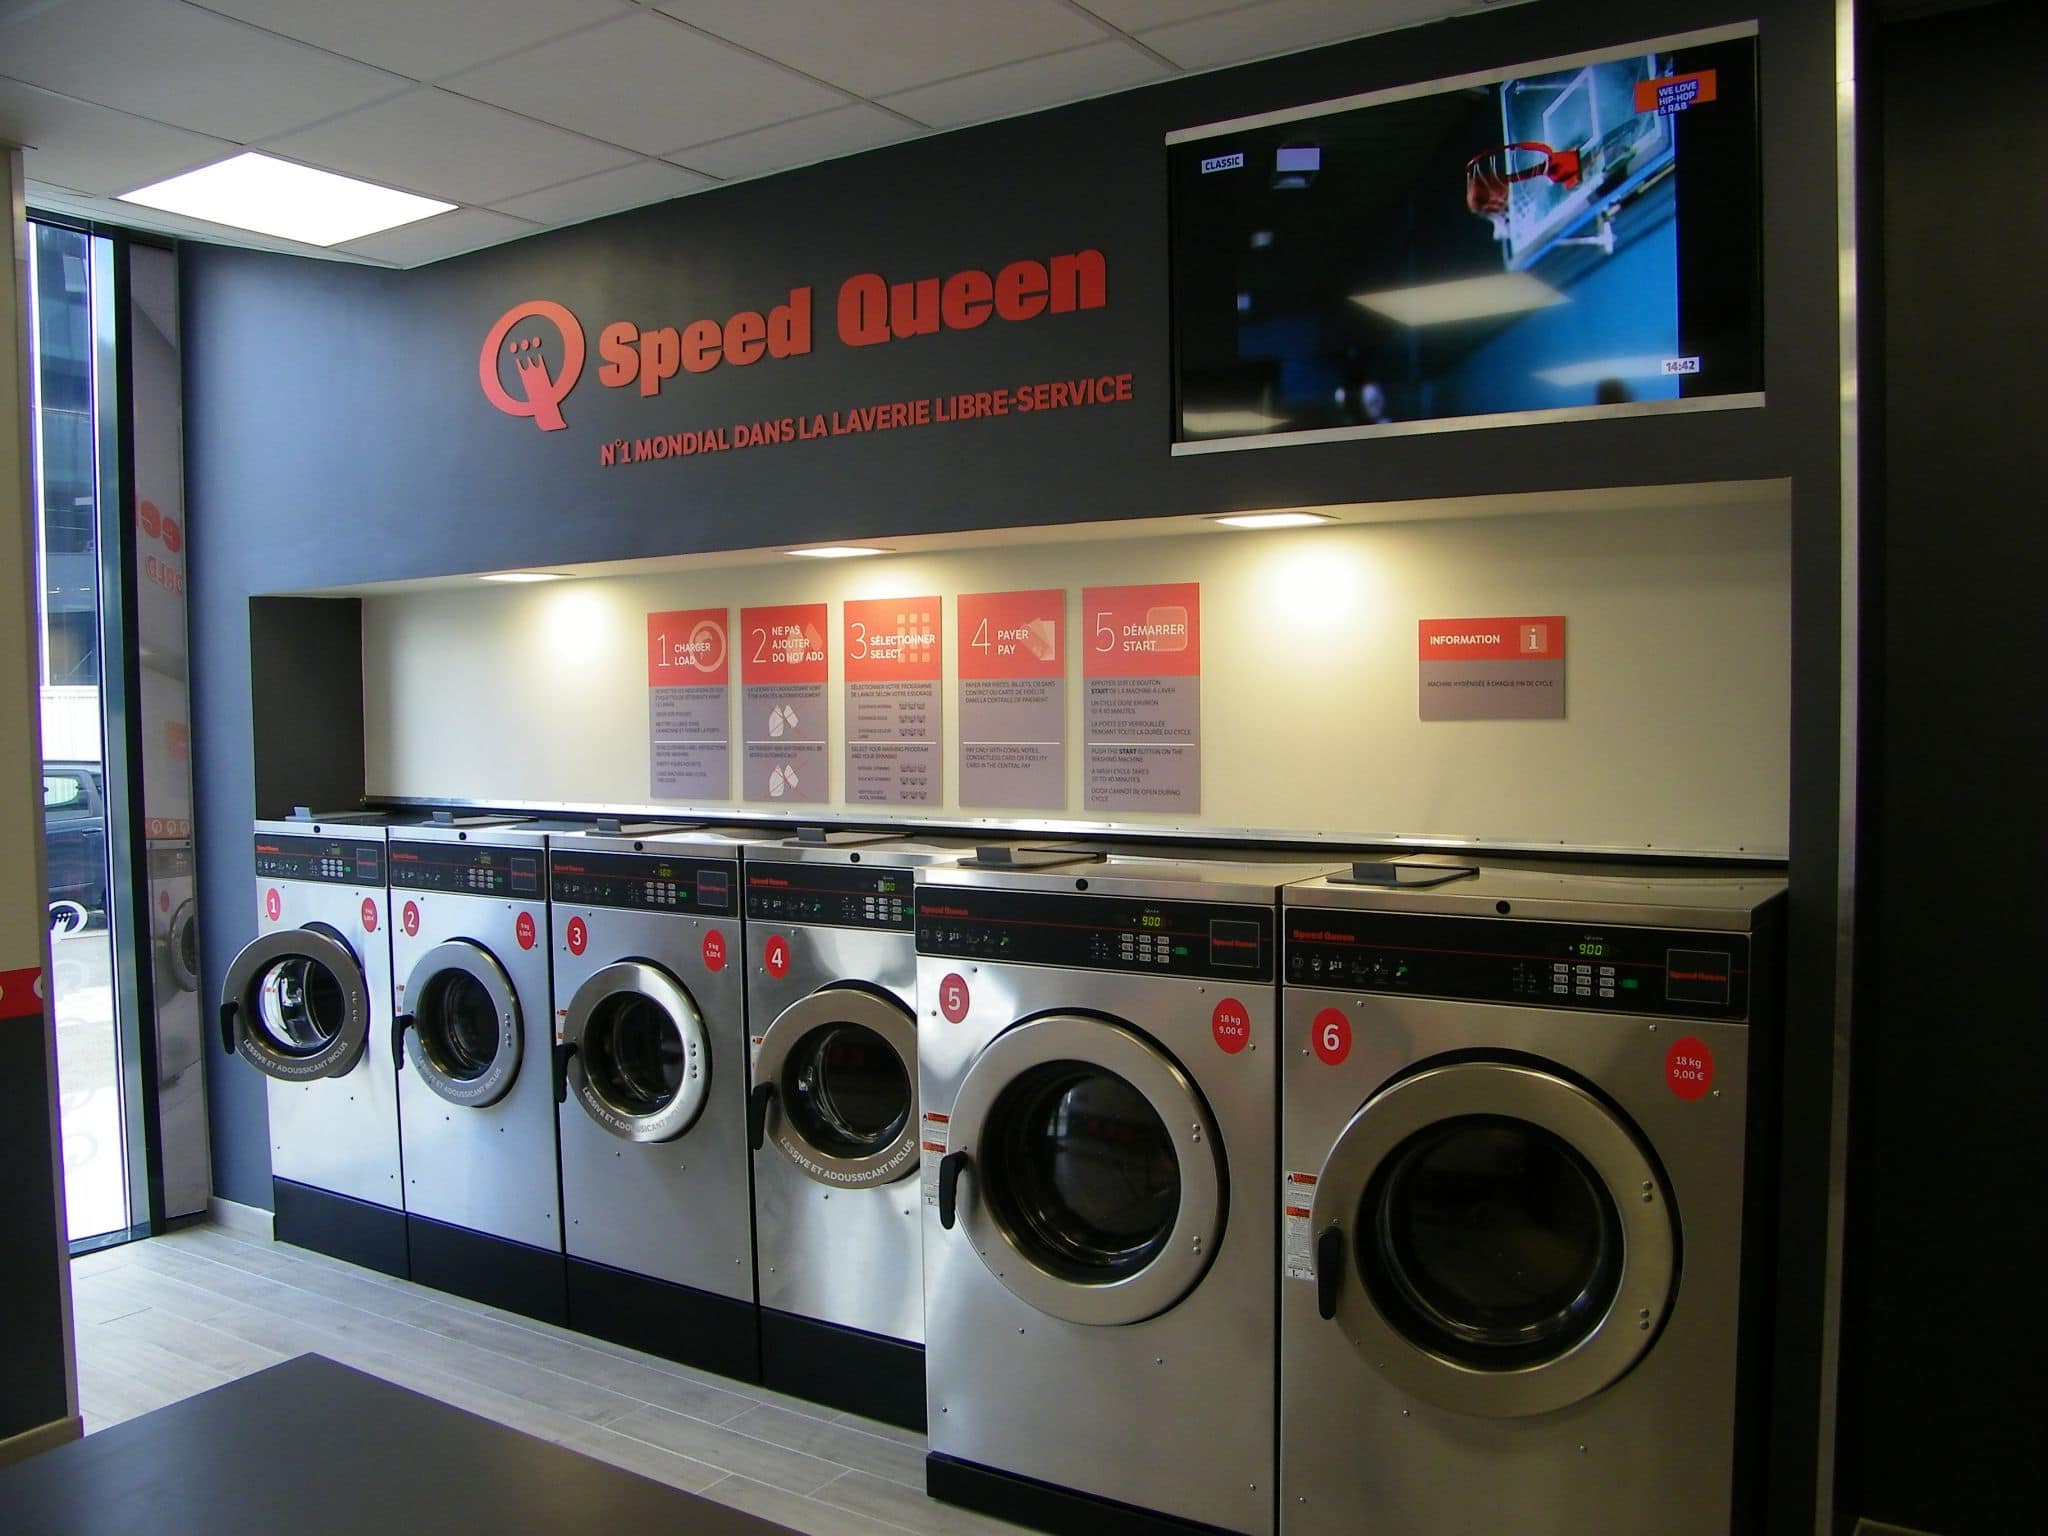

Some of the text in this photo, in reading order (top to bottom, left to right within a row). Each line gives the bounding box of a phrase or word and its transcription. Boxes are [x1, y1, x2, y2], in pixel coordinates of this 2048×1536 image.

[1659, 81, 1696, 96] WE LOVE
[1659, 91, 1695, 106] HIP-HOP
[1668, 102, 1688, 112] R&B
[1206, 156, 1240, 170] CLASSIC
[598, 248, 1108, 397] Speed Queen
[1666, 360, 1695, 372] 14:42
[635, 428, 730, 462] MONDIAL
[734, 418, 795, 448] DANS
[799, 414, 828, 440] LA
[832, 399, 930, 435] LAVERIE
[936, 374, 1133, 422] LIBRE-SERVICE
[772, 625, 800, 636] NE PAS
[998, 630, 1028, 640] PAYER
[1096, 612, 1114, 652] 5
[1123, 624, 1184, 636] DÉMARRER
[772, 638, 810, 649] AJOUTER
[851, 622, 867, 660] 3
[870, 634, 936, 646] SÉLECTIONNER
[972, 618, 991, 656] 4
[1430, 634, 1500, 646] INFORMATION
[657, 634, 670, 666] 1
[674, 642, 711, 653] CHARGER
[752, 628, 766, 663] 2
[998, 645, 1016, 656] PAY
[1123, 641, 1156, 652] START
[772, 652, 824, 662] DO NOT ADD
[870, 648, 902, 659] SELECT
[674, 656, 696, 666] LOAD
[270, 898, 276, 914] 1
[408, 911, 415, 928] 2
[1143, 916, 1160, 926] 900
[573, 927, 582, 946] 3
[1580, 944, 1602, 956] 900
[771, 948, 783, 968] 4
[948, 986, 960, 1011] 5
[1220, 1014, 1240, 1026] 18 kg
[1322, 1023, 1340, 1052] 6
[328, 1042, 348, 1064] INCLUS
[1676, 1056, 1702, 1069] 18 kg
[1674, 1068, 1704, 1080] 9,00 €
[582, 1086, 605, 1118] LESSIVE
[605, 1112, 614, 1123] ET
[780, 1136, 810, 1169] LESSIVE
[811, 1164, 823, 1175] ET
[824, 1165, 889, 1182] ADOUSSICANT
[888, 1138, 915, 1168] INCLUS
